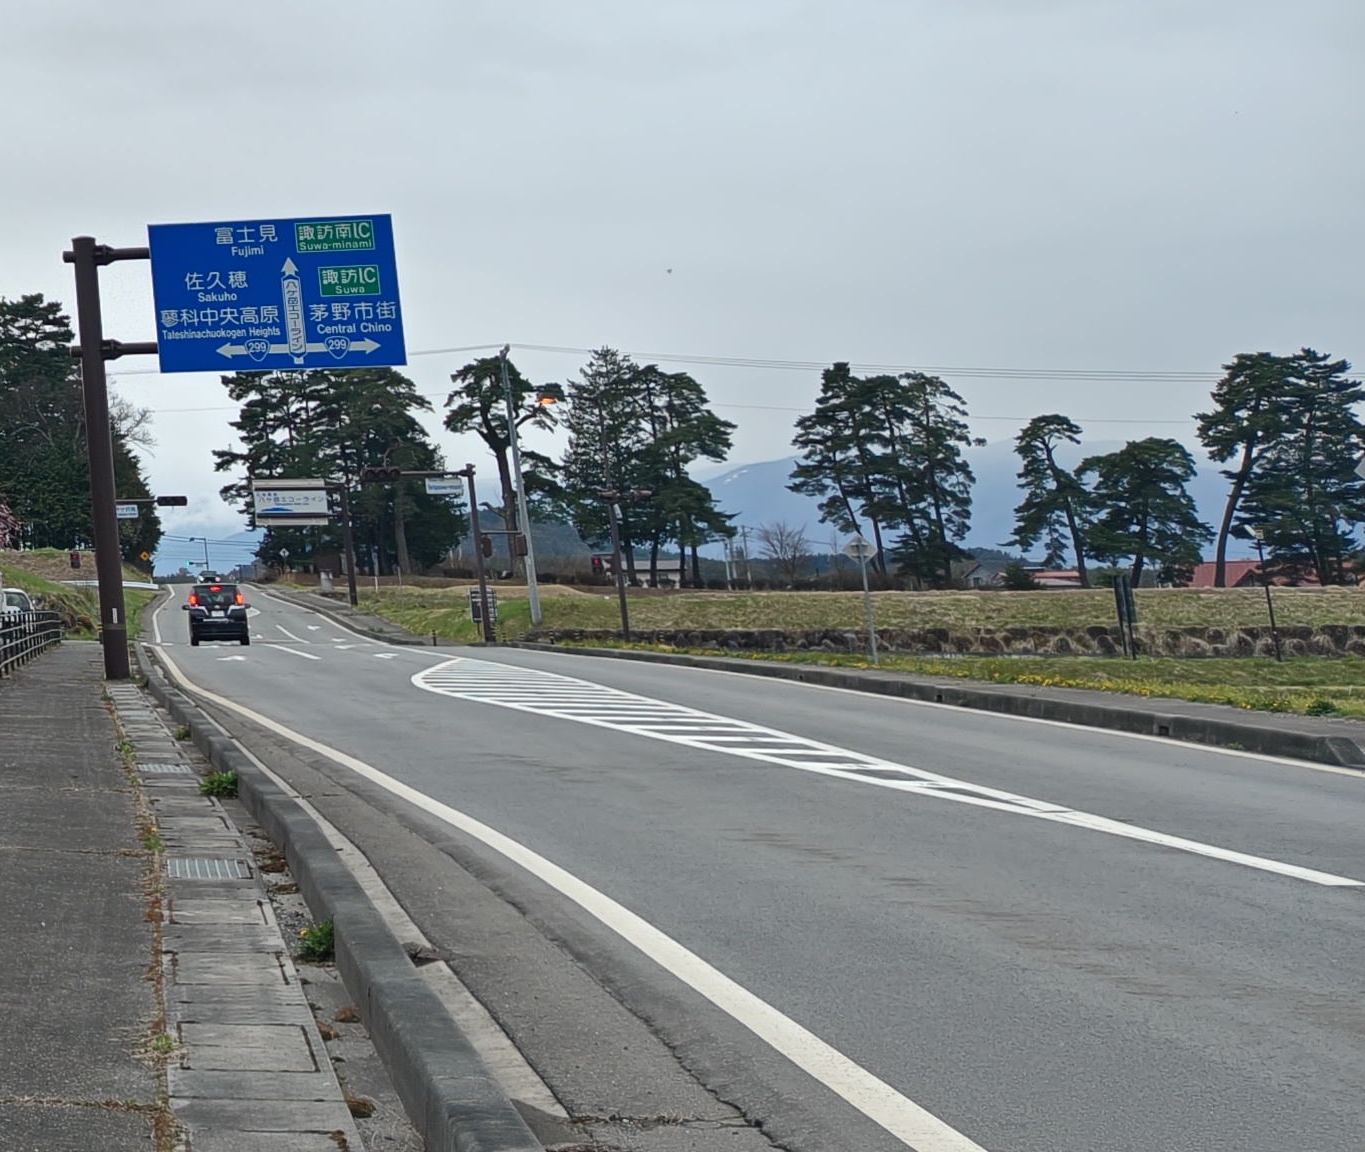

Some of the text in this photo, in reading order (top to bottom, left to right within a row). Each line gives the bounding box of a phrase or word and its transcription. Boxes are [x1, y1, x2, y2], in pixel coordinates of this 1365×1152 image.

[214, 225, 278, 245] 富士見
[299, 222, 371, 241] 諏訪南IC
[231, 245, 265, 257] Fujimi
[299, 239, 372, 251] Suwa-minami
[184, 270, 248, 290] 佐久穂
[321, 267, 377, 285] 諏訪IC
[197, 291, 238, 302] Sakuho
[335, 285, 365, 295] Suwa
[160, 305, 280, 328] 蓼科中央高原
[308, 300, 397, 322] 茅野市街
[162, 326, 281, 340] Tateshinachuokogen Heights
[316, 322, 392, 334] Central Chino
[248, 342, 267, 353] 299
[327, 339, 347, 350] 299
